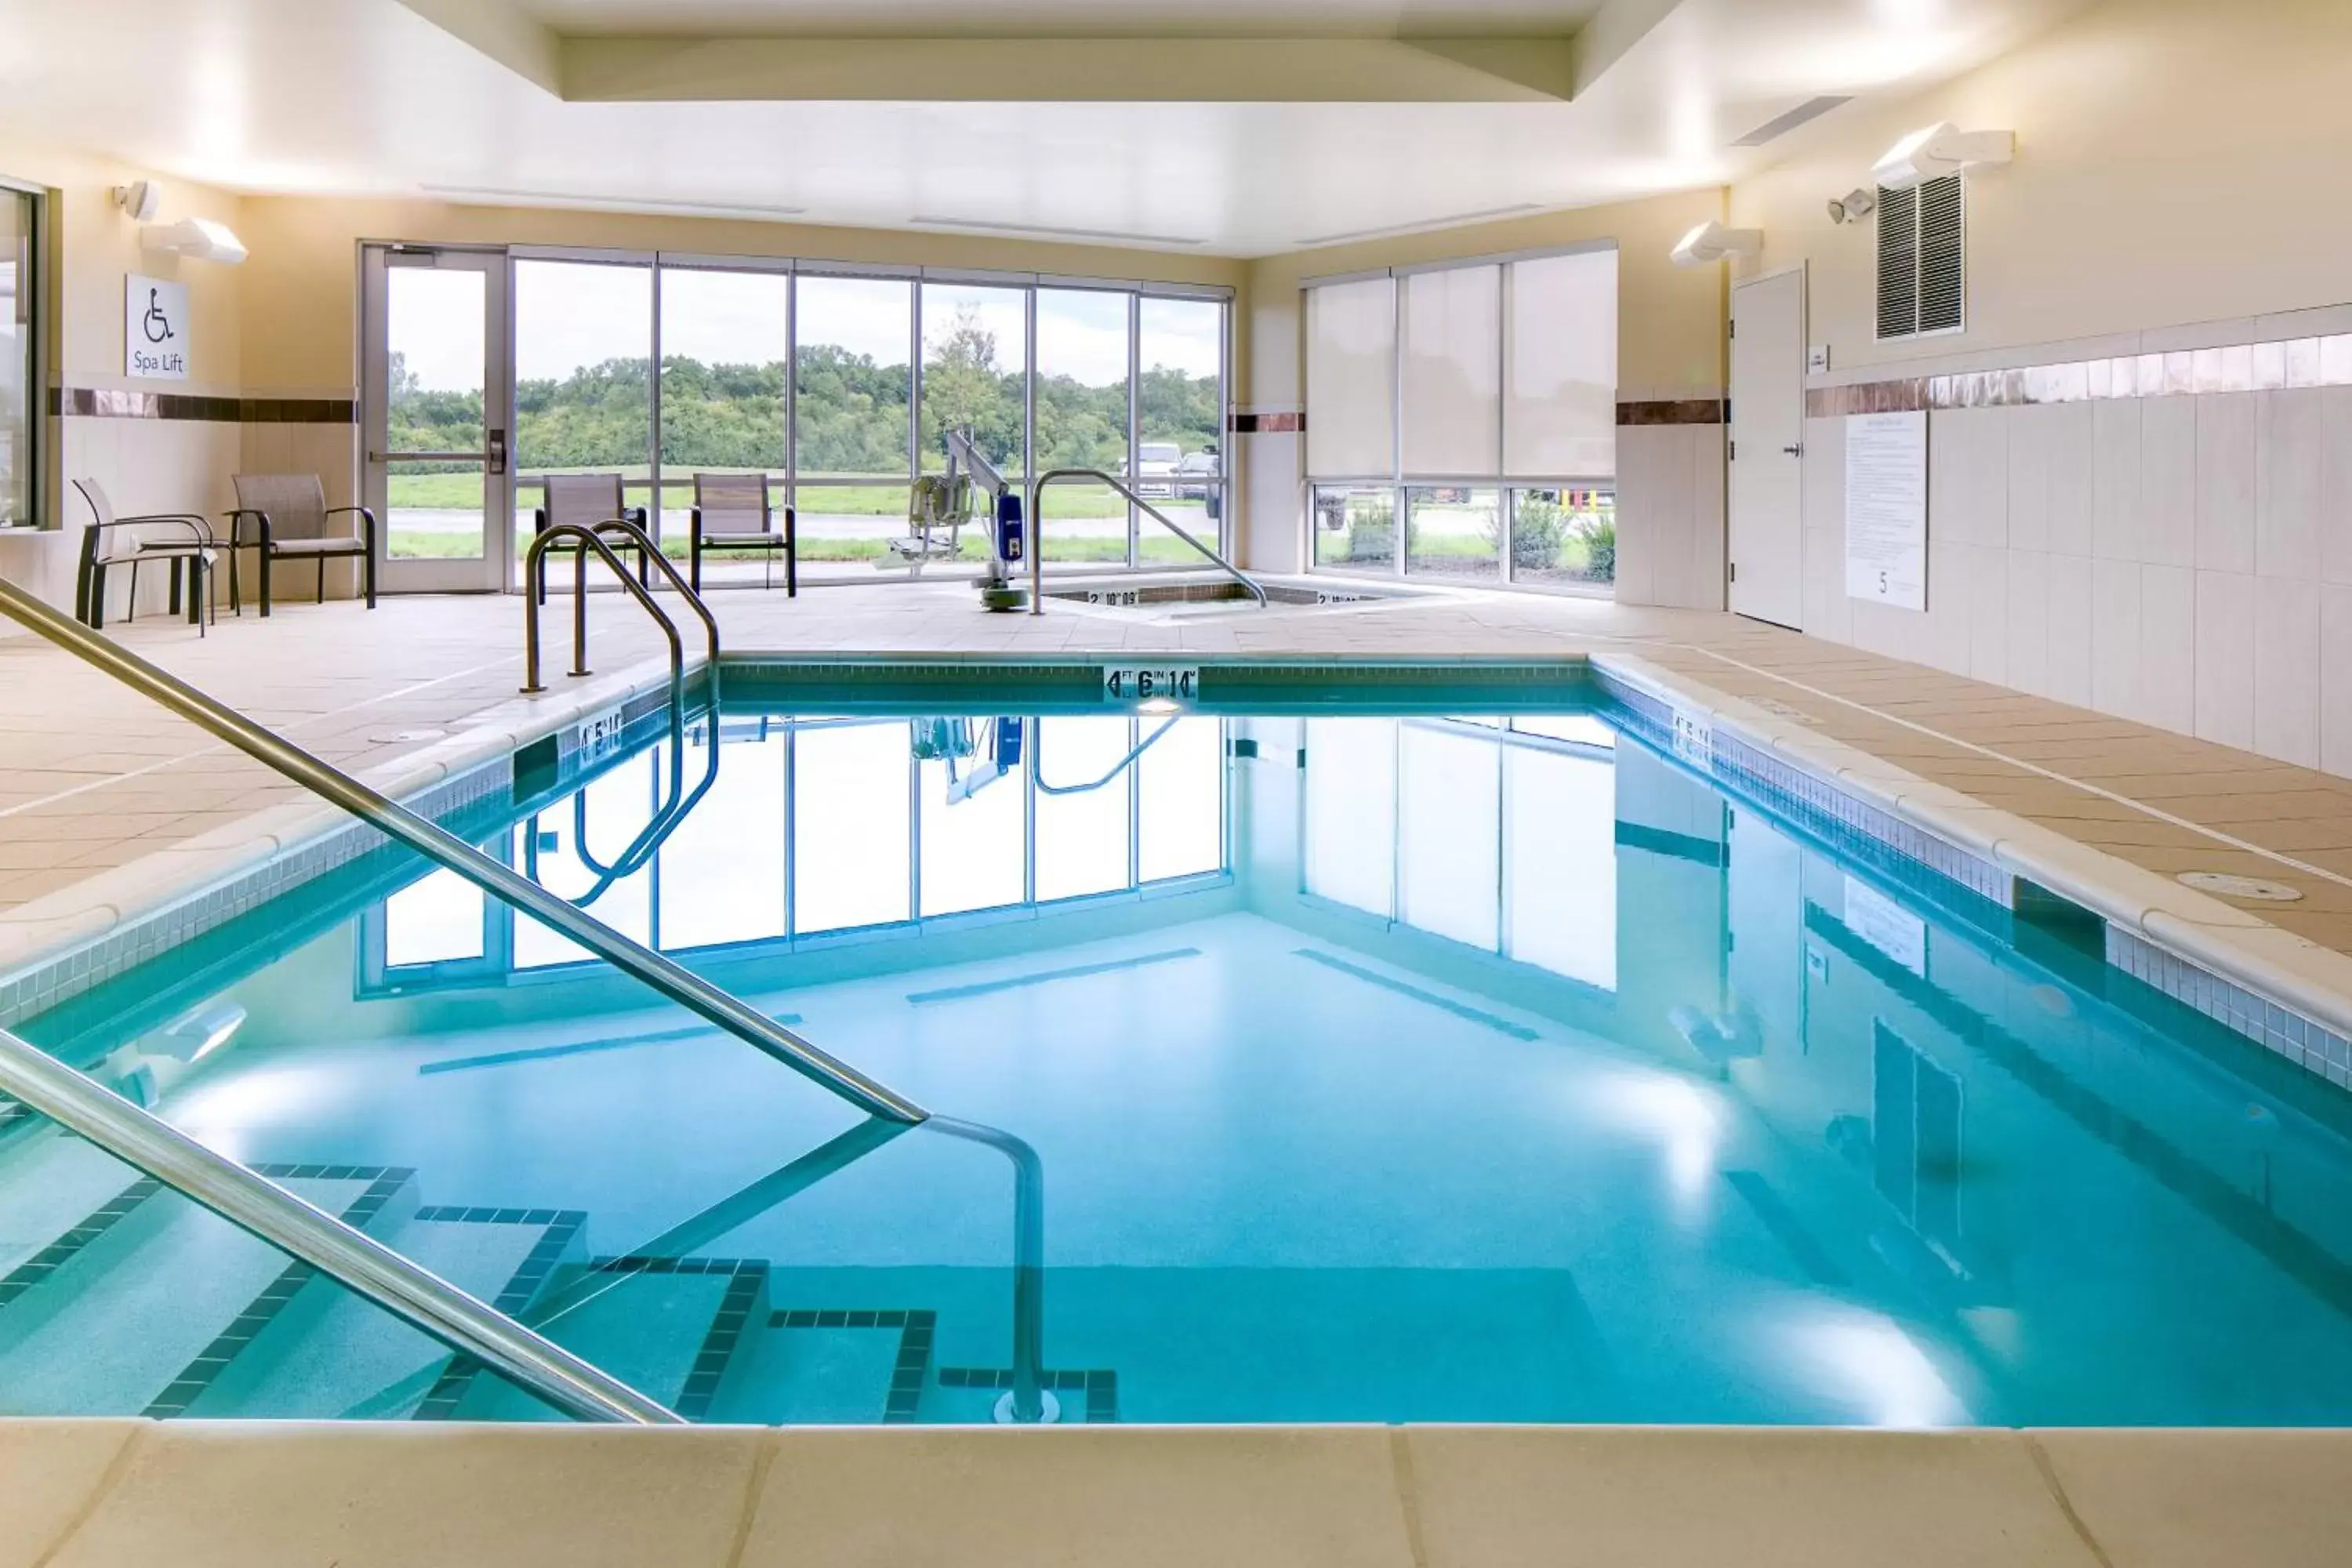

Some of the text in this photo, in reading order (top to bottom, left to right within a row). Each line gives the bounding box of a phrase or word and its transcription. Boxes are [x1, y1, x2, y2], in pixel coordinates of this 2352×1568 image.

[134, 350, 183, 375] Spa Lift
[1879, 571, 1888, 593] 5
